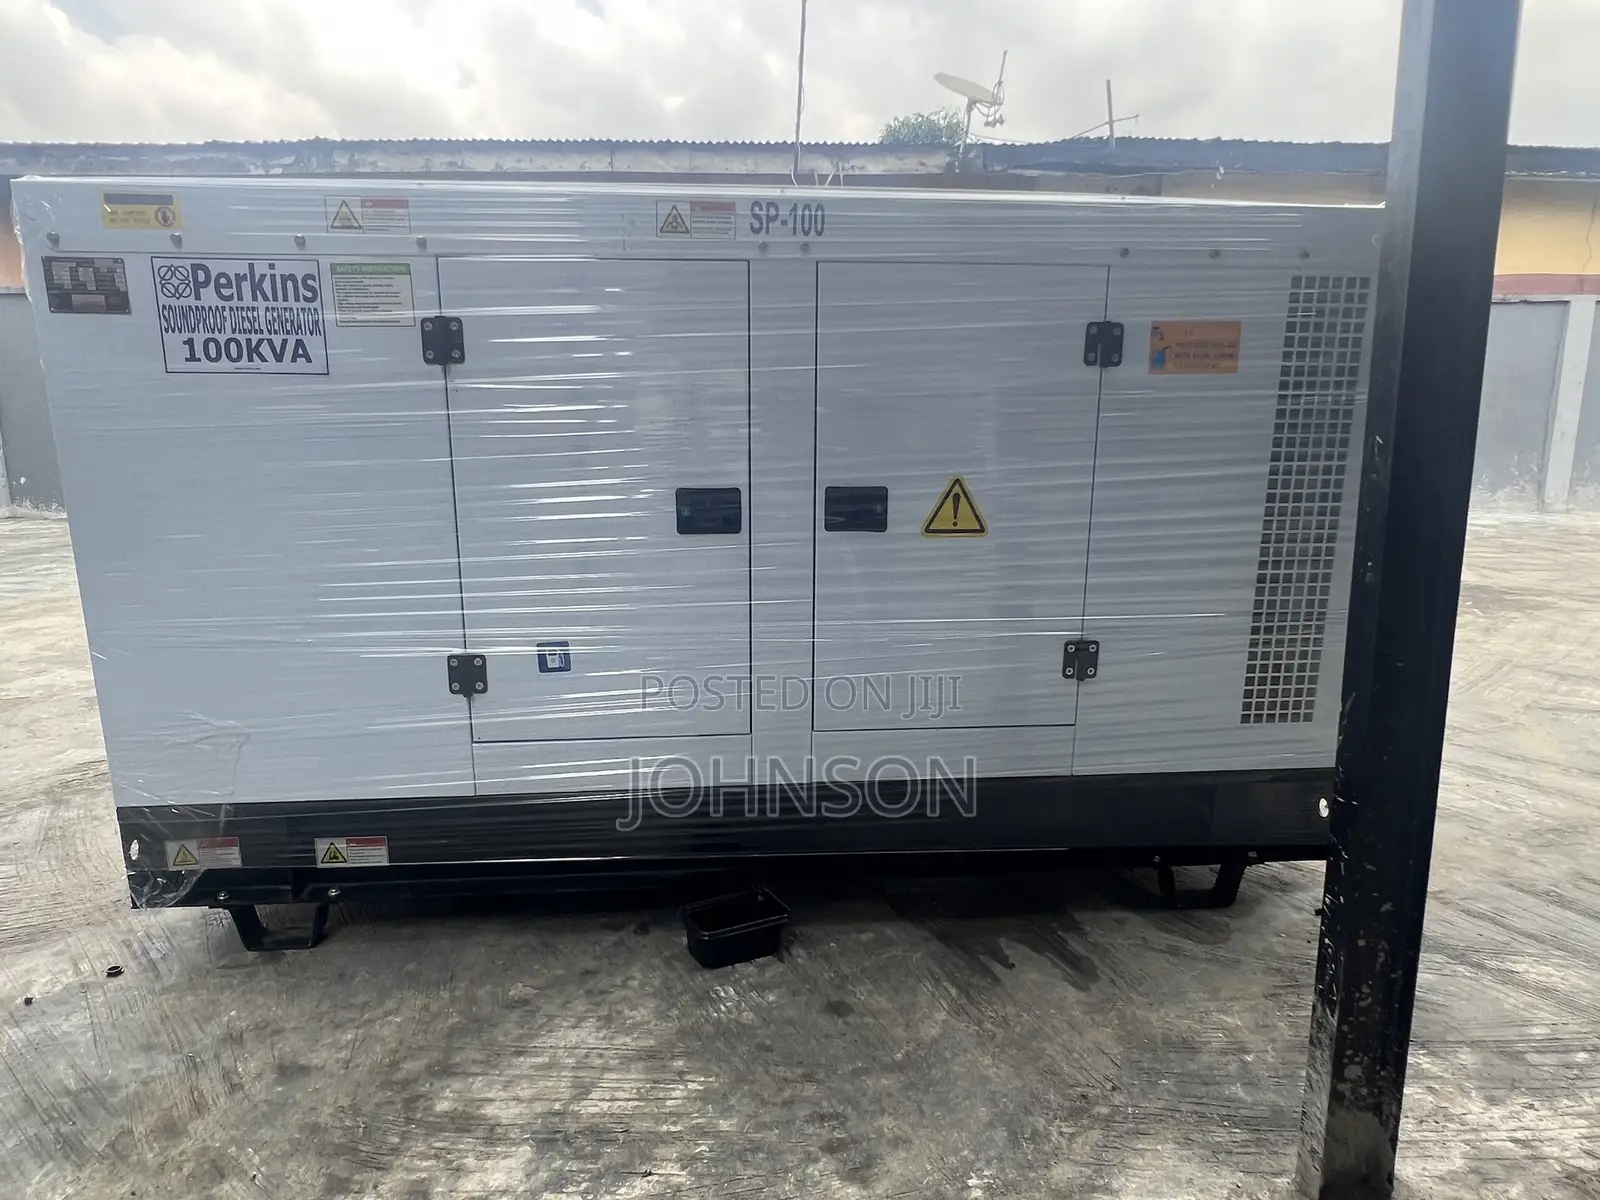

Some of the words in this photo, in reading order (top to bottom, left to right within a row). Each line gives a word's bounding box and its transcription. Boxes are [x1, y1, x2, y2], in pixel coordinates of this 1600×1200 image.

[750, 201, 825, 236] SP-100
[192, 263, 318, 303] Perkins
[162, 304, 228, 335] SOUNDPROOF
[229, 306, 264, 335] DIESEL
[265, 307, 322, 337] GENERATOR
[183, 338, 313, 364] 100KVA
